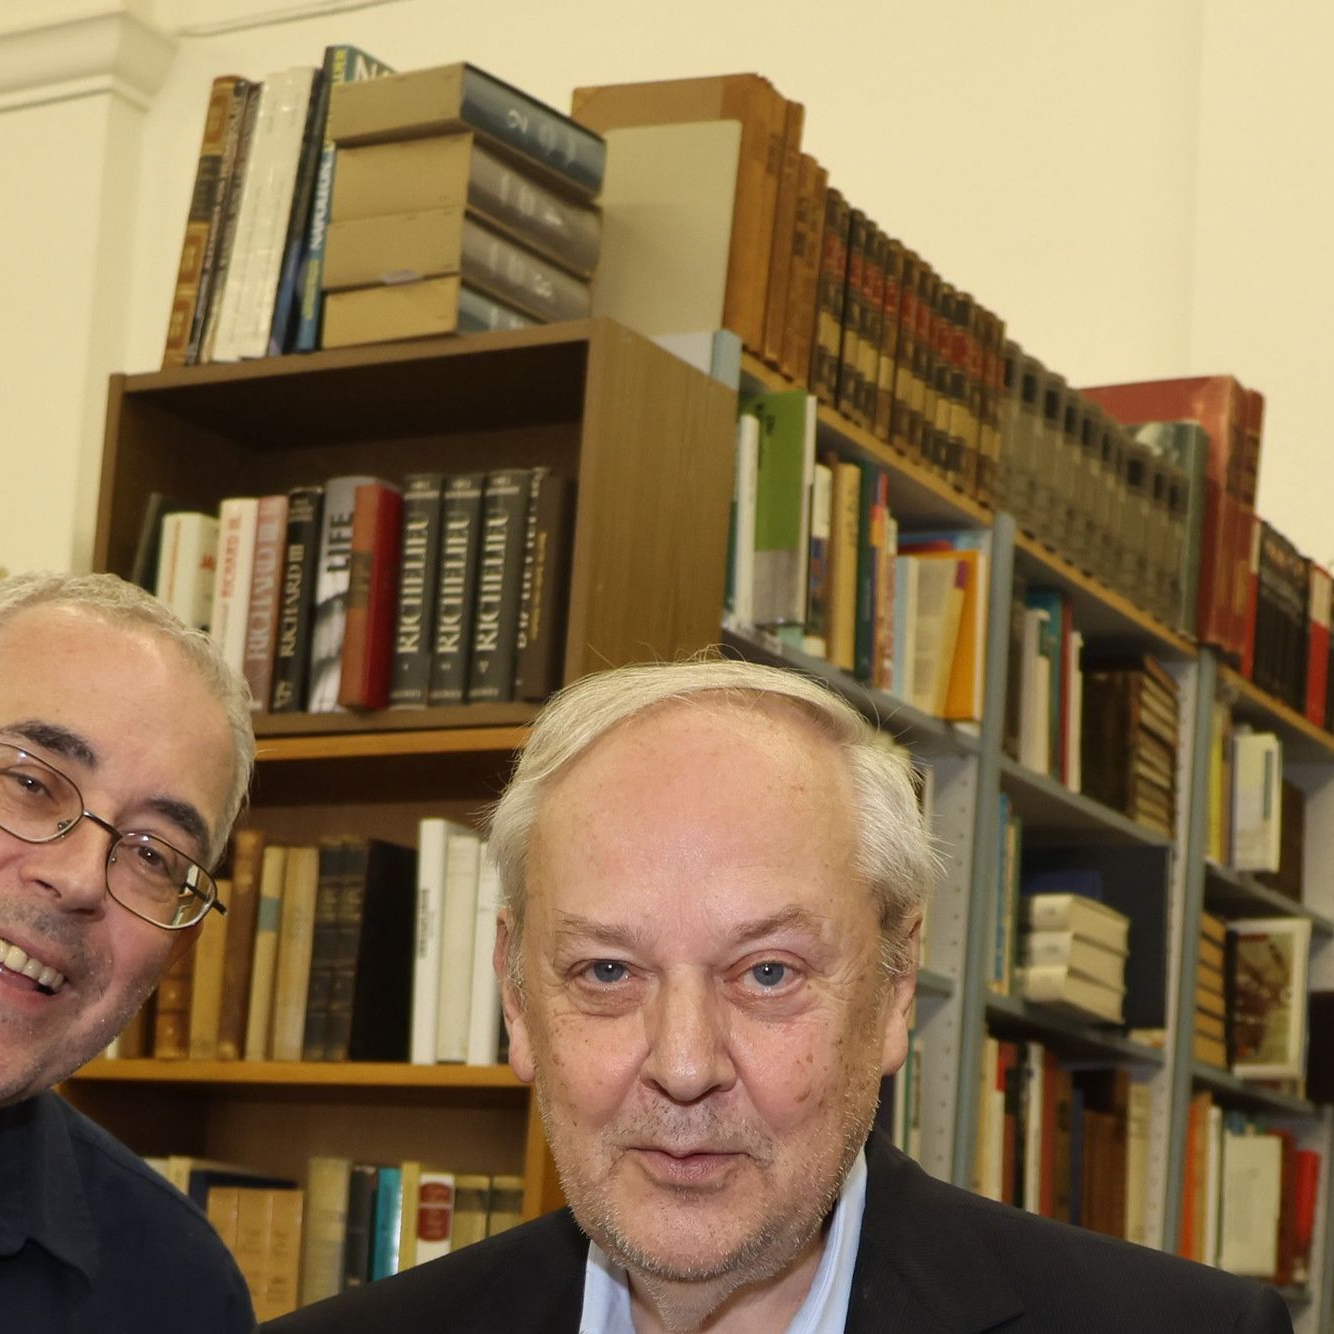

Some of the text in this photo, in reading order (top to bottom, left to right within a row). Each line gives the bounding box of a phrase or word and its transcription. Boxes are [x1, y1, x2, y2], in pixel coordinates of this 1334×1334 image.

[326, 512, 353, 572] LIFE
[397, 517, 430, 653] RICHELIEU
[436, 517, 470, 653] RICHELIEU
[476, 513, 509, 651] RICHELIEU
[279, 563, 304, 658] RICHARD
